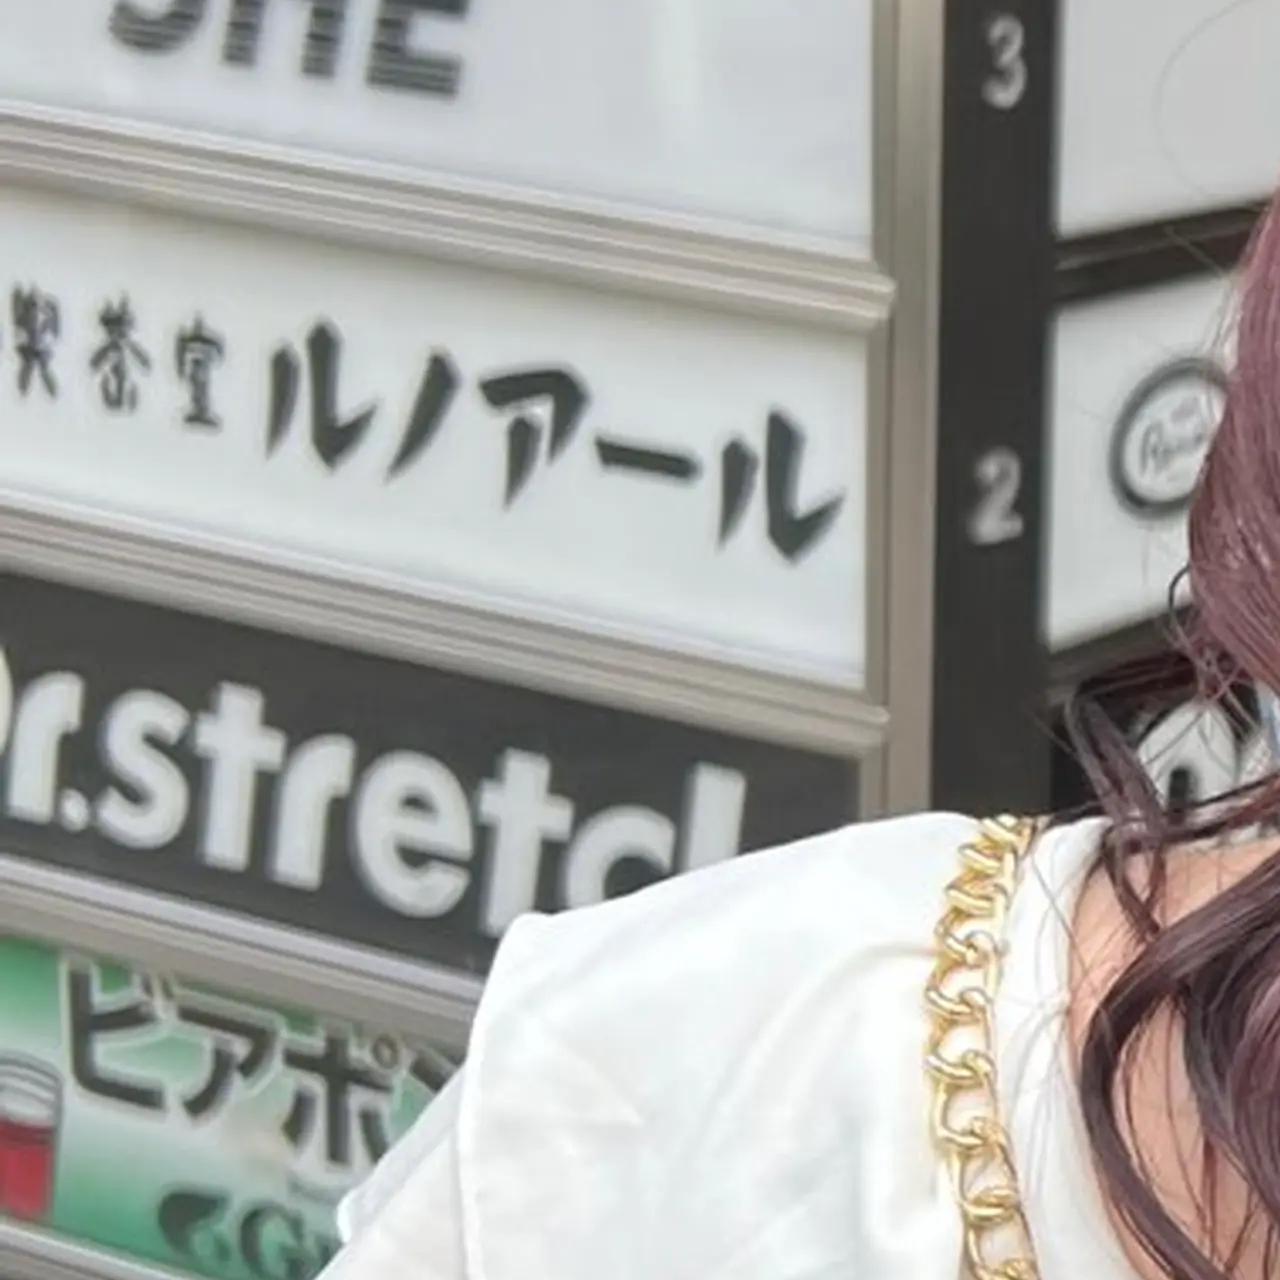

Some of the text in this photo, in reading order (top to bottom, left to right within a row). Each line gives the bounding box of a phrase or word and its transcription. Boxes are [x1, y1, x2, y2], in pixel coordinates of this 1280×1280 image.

[982, 13, 1028, 110] 3
[968, 446, 1024, 546] 2
[0, 642, 746, 932] r.stretc
[68, 960, 456, 1166] ビアポ
